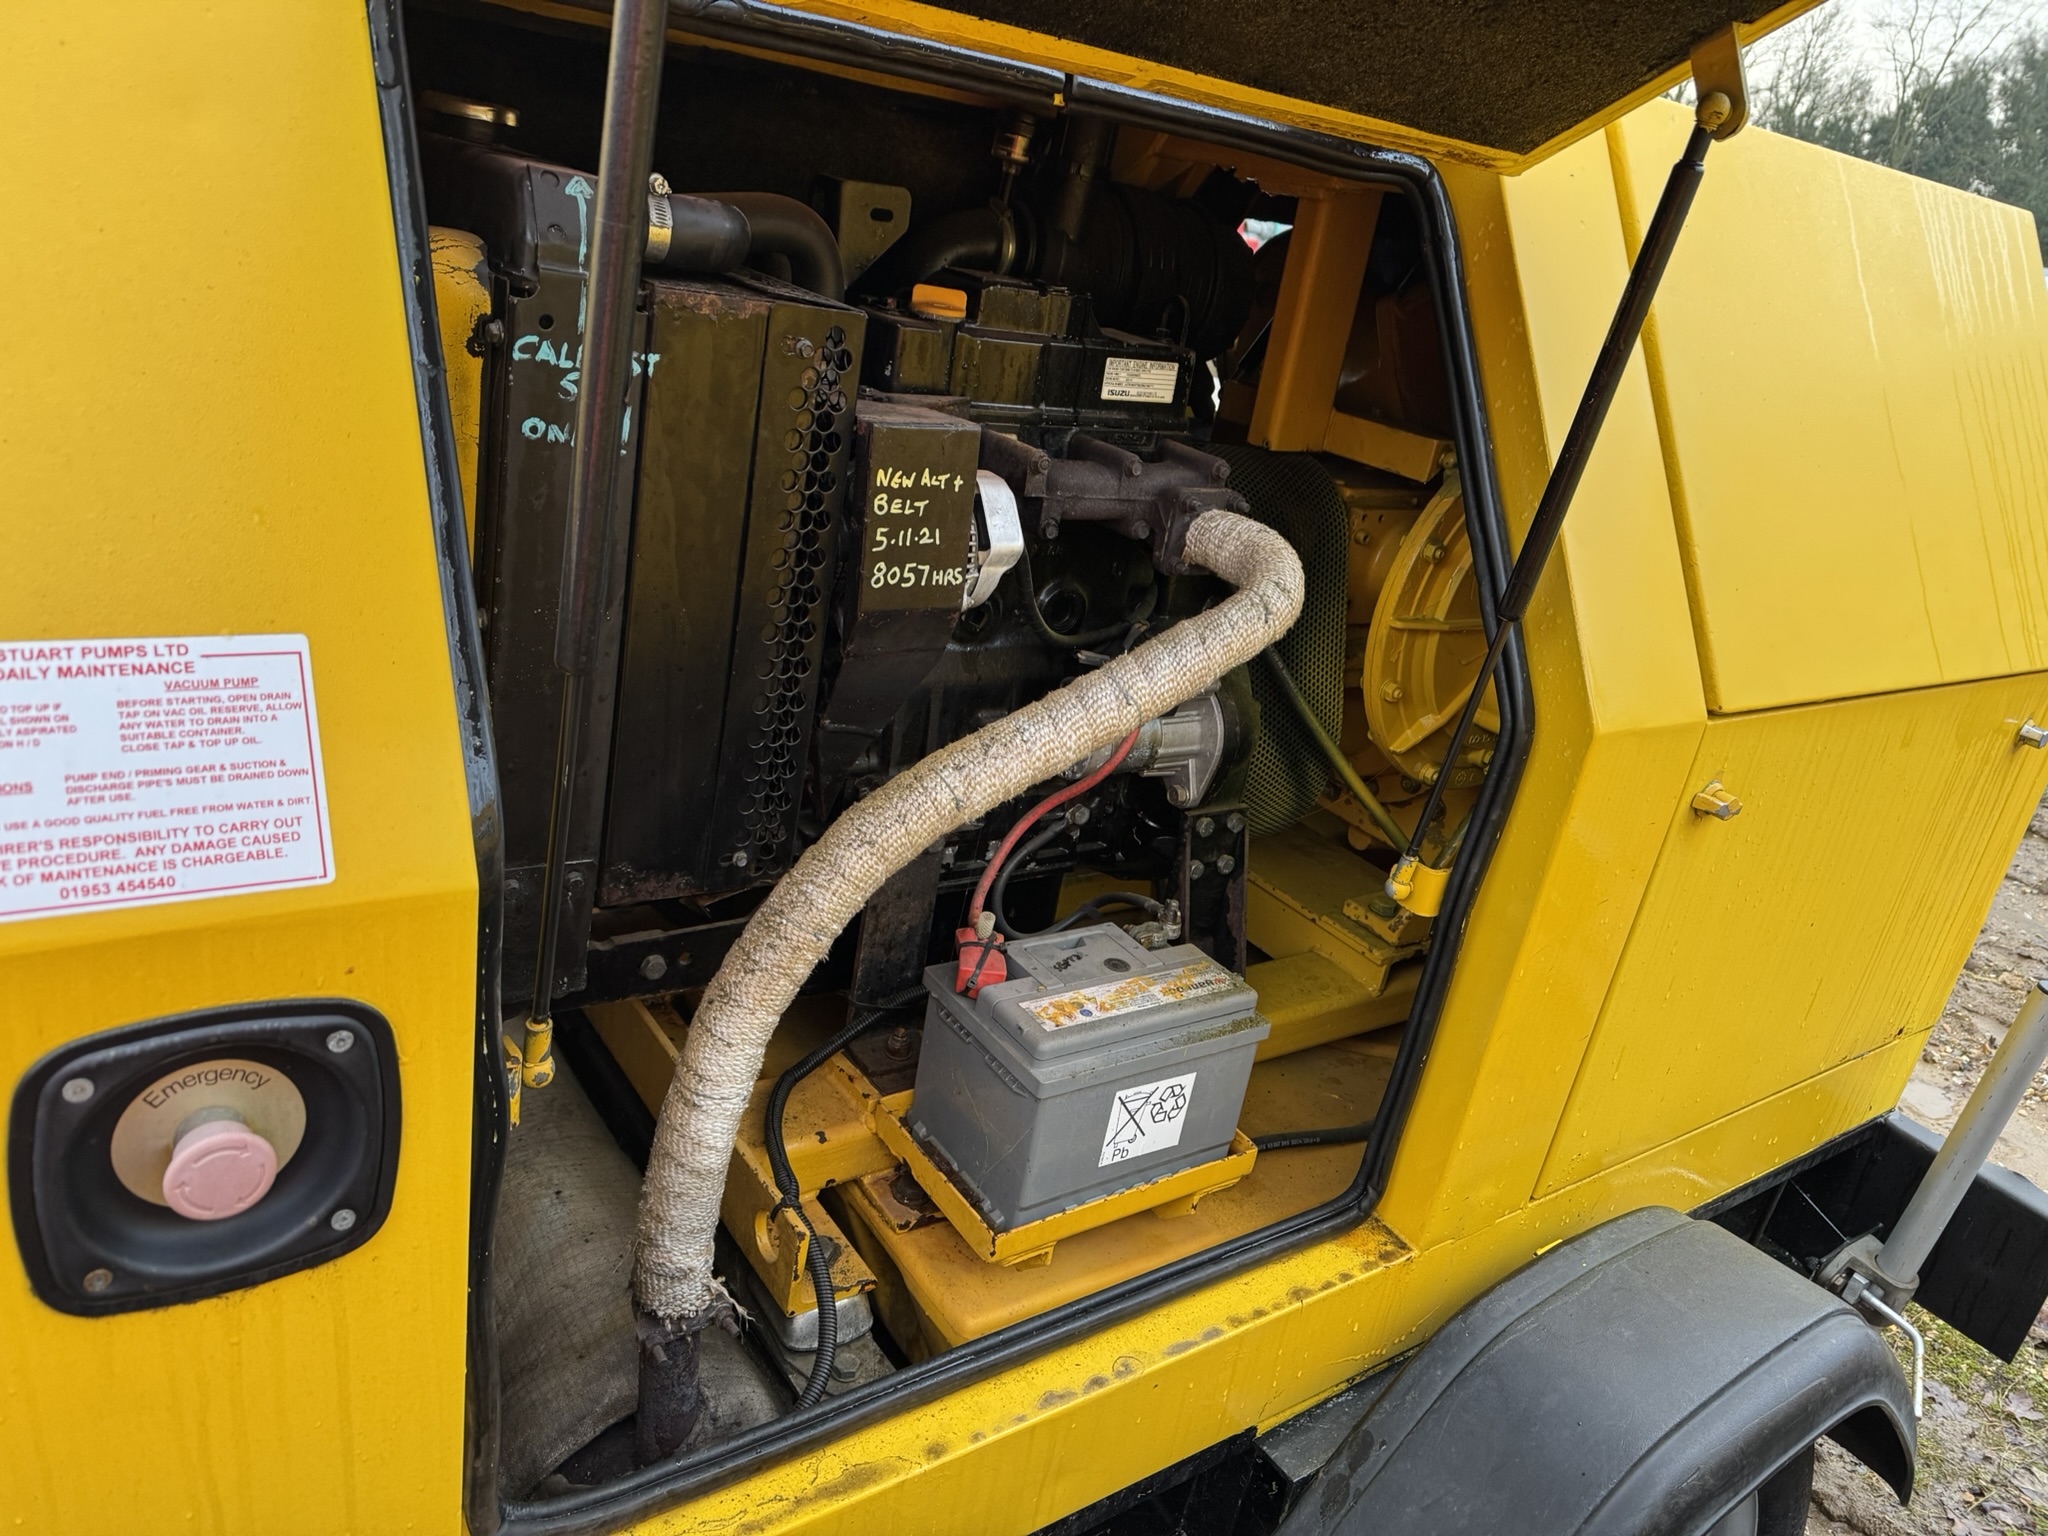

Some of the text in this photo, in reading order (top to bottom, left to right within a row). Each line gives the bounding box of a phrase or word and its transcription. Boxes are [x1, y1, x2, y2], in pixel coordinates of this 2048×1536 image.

[1107, 389, 1130, 397] ISUZU
[876, 467, 917, 489] NEW
[920, 467, 951, 490] ALT
[873, 493, 930, 517] BELT
[81, 645, 147, 659] PUMPS
[154, 644, 188, 656] LTD
[57, 661, 195, 678] MAINTENANCE
[164, 677, 258, 691] VACUUM PUMP
[11, 704, 33, 712] TOP
[116, 698, 163, 708] BEFORE
[228, 694, 256, 702] OPEN
[260, 692, 291, 700] DRAIN
[118, 710, 140, 718] TAP
[143, 709, 160, 717] ON
[164, 708, 185, 716] VAC
[265, 702, 303, 710] ALLOW
[10, 715, 51, 725] SHOWN
[54, 714, 69, 722] ON
[119, 722, 141, 730] ANY
[144, 719, 186, 728] WATER
[189, 718, 204, 726] TO
[207, 716, 240, 724] DRAIN
[16, 725, 77, 735] ASPIRATED
[120, 730, 176, 741] SUITABLE
[121, 742, 161, 752] CLOSE
[164, 741, 185, 749] TAP
[224, 737, 239, 745] UP
[64, 773, 98, 782] PUMP
[101, 771, 125, 779] END
[134, 767, 182, 777] PRIMING
[186, 764, 216, 773] GEAR
[230, 760, 277, 770] SUCTION
[65, 768, 309, 794] DISCHARGE PIPE'S MUST BE DRAINED DOWN
[67, 795, 105, 805] AFTER
[4, 821, 27, 830] USE
[44, 817, 80, 827] GOOD
[84, 812, 134, 823] QUALITY
[137, 810, 167, 818] FUEL
[169, 806, 199, 815] FREE
[201, 804, 234, 813] FROM
[236, 800, 275, 810] WATER
[59, 828, 188, 848] RESPONSIBILITY
[194, 825, 215, 836] TO
[218, 820, 270, 834] CARRY
[274, 817, 302, 829] OUT
[135, 845, 165, 857] ANY
[171, 838, 237, 854] DAMAGE
[241, 831, 301, 847] CAUSED
[13, 873, 36, 886] OF
[40, 861, 158, 883] MAINTENANCE
[162, 859, 177, 869] IS
[59, 876, 176, 899] 01953 454540
[142, 1067, 272, 1109] Emergency
[1111, 1147, 1129, 1162] Pb
